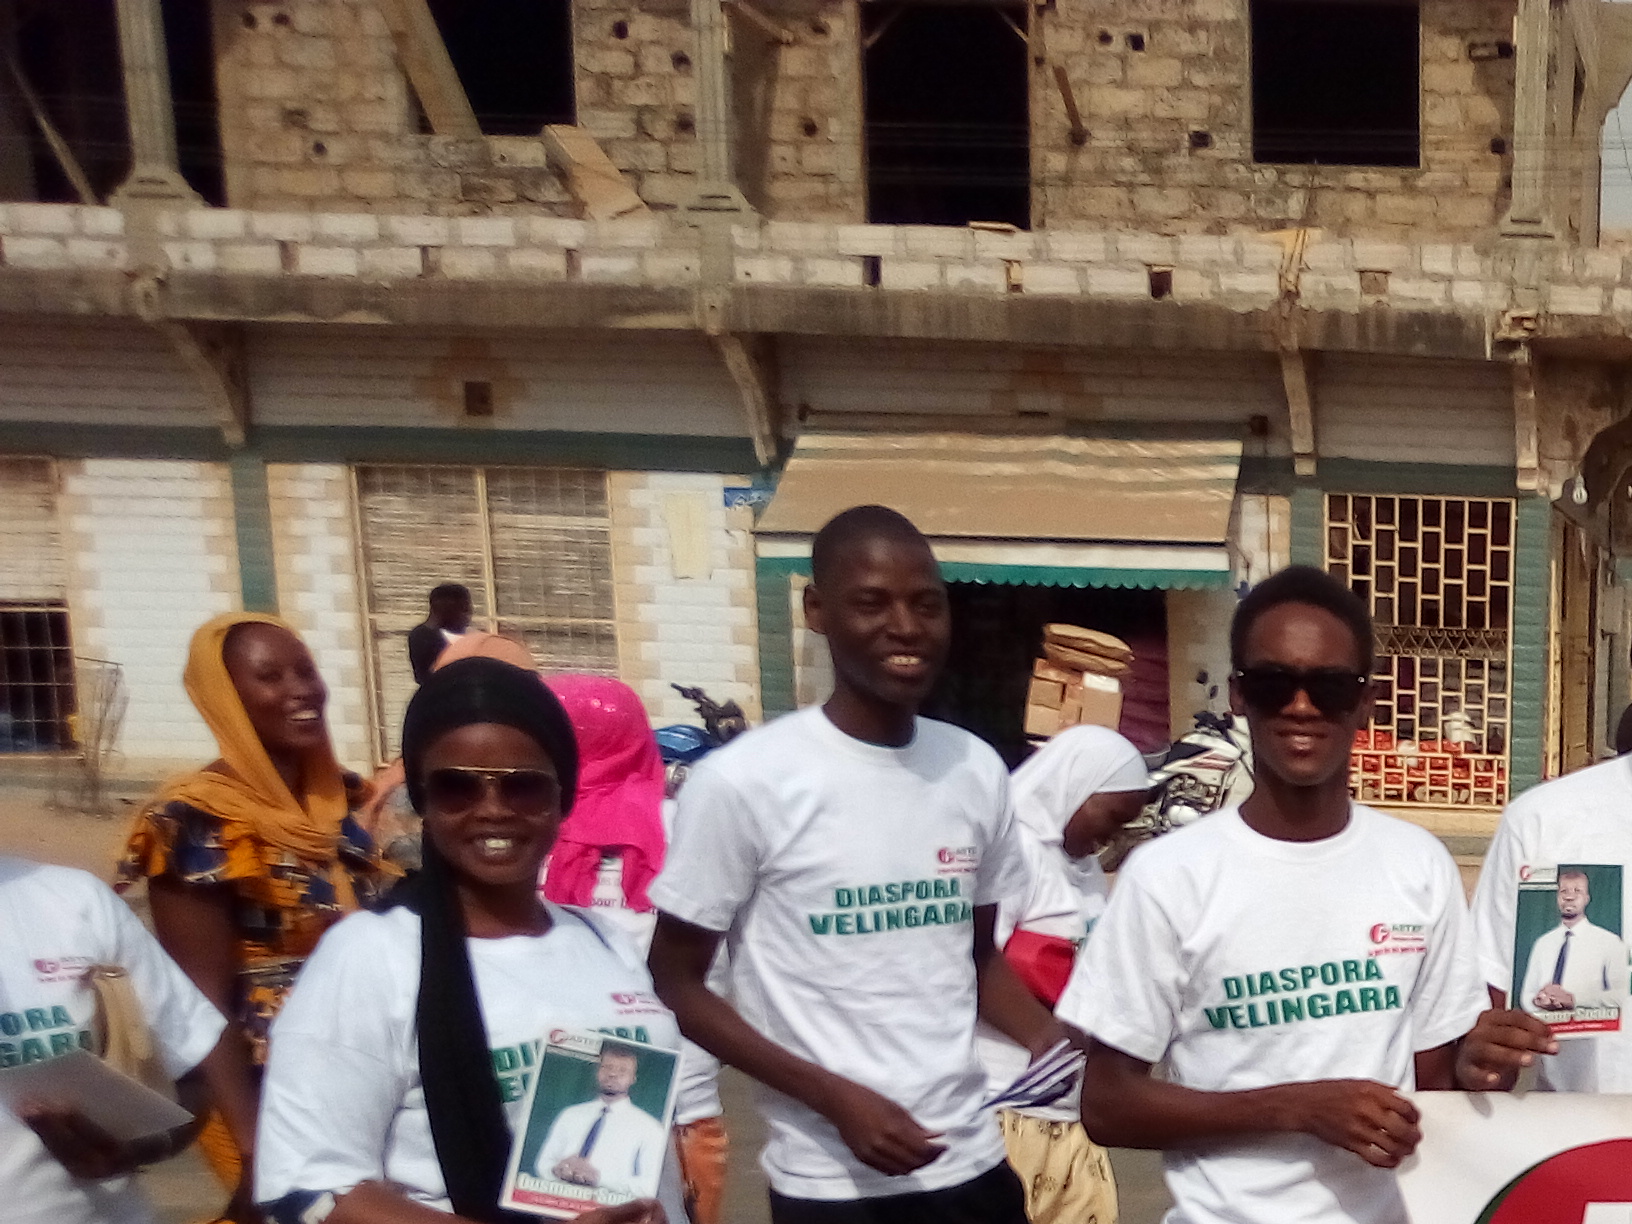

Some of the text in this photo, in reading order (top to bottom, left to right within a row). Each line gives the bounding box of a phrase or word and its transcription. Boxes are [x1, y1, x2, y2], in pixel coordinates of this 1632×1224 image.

[835, 877, 961, 907] DIASPORA
[808, 902, 973, 935] VELINGARA
[1222, 957, 1384, 999] DIASPORA
[1204, 985, 1404, 1029] VELINGARA
